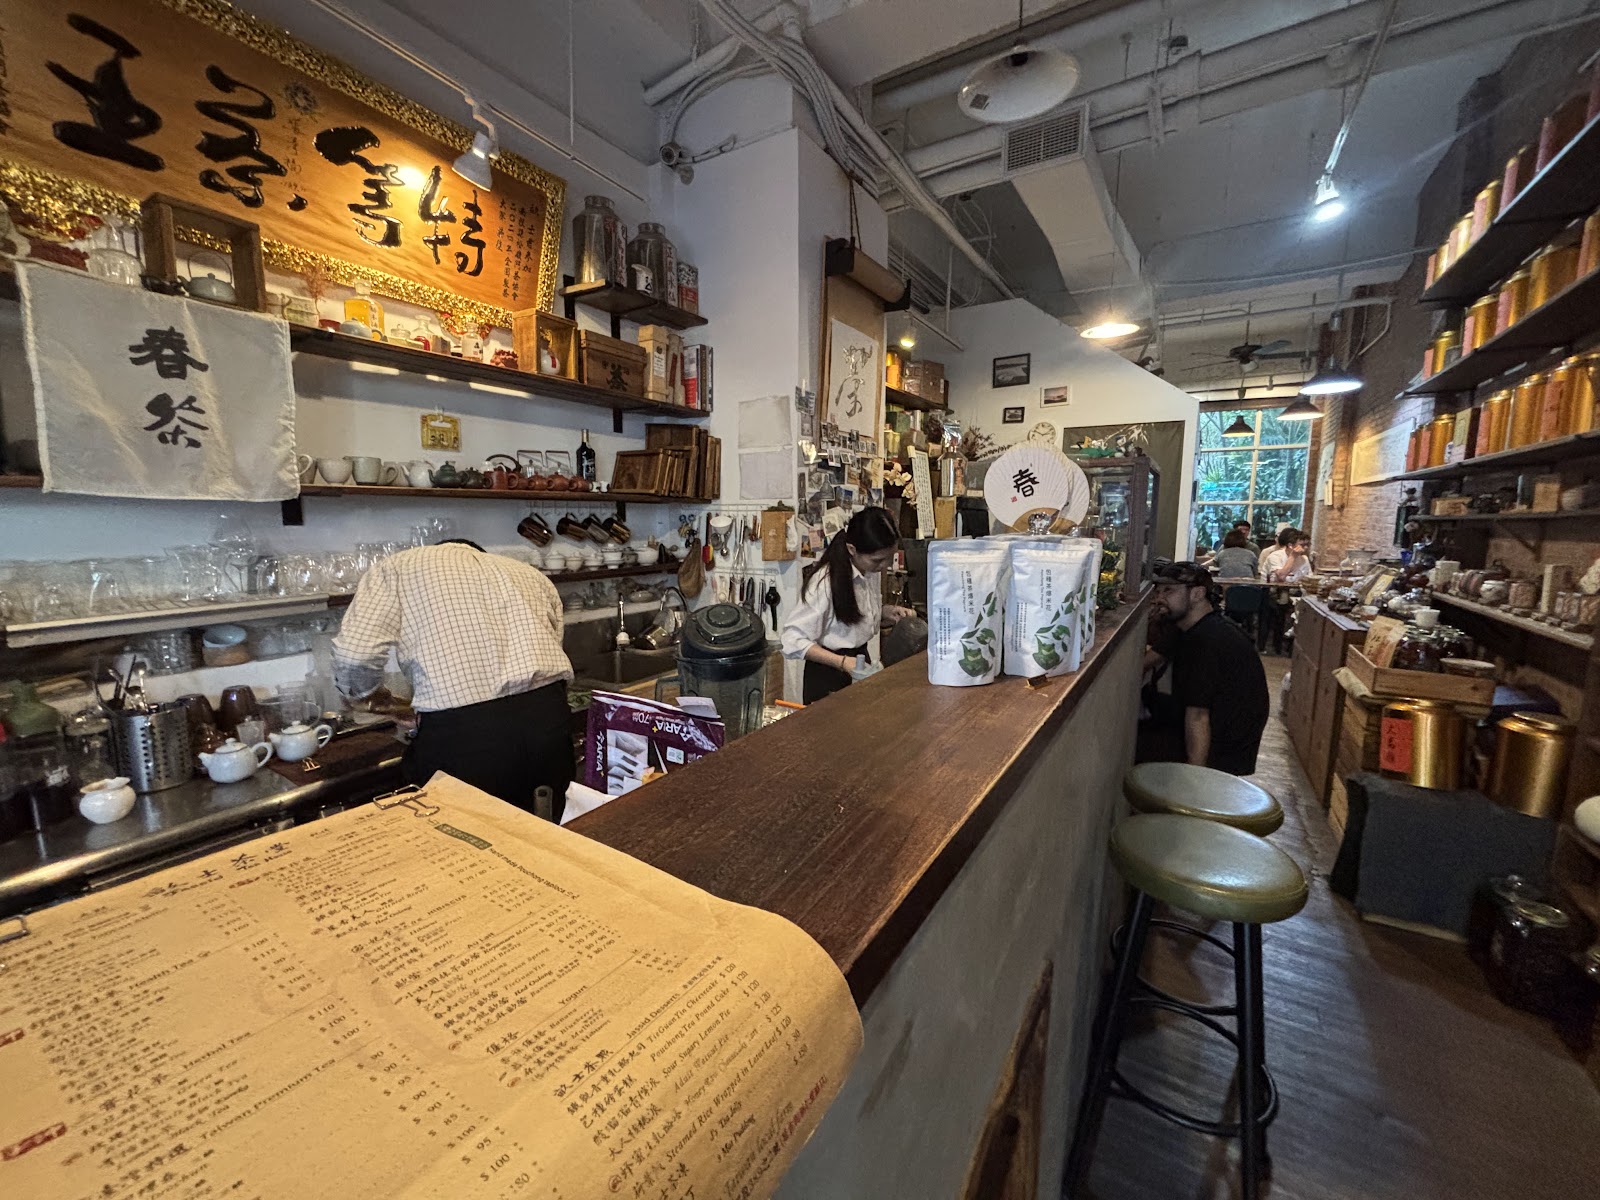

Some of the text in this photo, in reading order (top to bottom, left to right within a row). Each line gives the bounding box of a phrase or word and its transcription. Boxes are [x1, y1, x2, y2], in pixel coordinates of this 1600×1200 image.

[128, 325, 209, 449] 春茶
[1012, 468, 1040, 498] 春
[558, 985, 588, 1005] Yogurt
[647, 1009, 687, 1042] TieGuanYin
[686, 980, 718, 1008] Cheesecake
[724, 963, 736, 973] 120
[695, 1000, 715, 1021] Pound
[714, 988, 729, 1002] Cake
[736, 971, 748, 981] 120
[760, 991, 771, 1003] 120
[770, 1003, 782, 1016] 125
[627, 1017, 651, 1039] Jassid
[650, 993, 680, 1018] Desserts
[662, 1060, 677, 1078] Sour
[679, 1040, 700, 1062] Sugary
[699, 1019, 720, 1040] Lemon
[719, 1009, 730, 1020] Pie
[748, 979, 760, 991] 120
[666, 1123, 697, 1162] Steamed
[697, 1107, 713, 1127] Rice
[713, 1073, 741, 1106] Wrapped
[741, 1067, 749, 1076] in
[781, 1016, 791, 1030] 120
[476, 1137, 491, 1150] 95
[490, 1154, 510, 1172] 100
